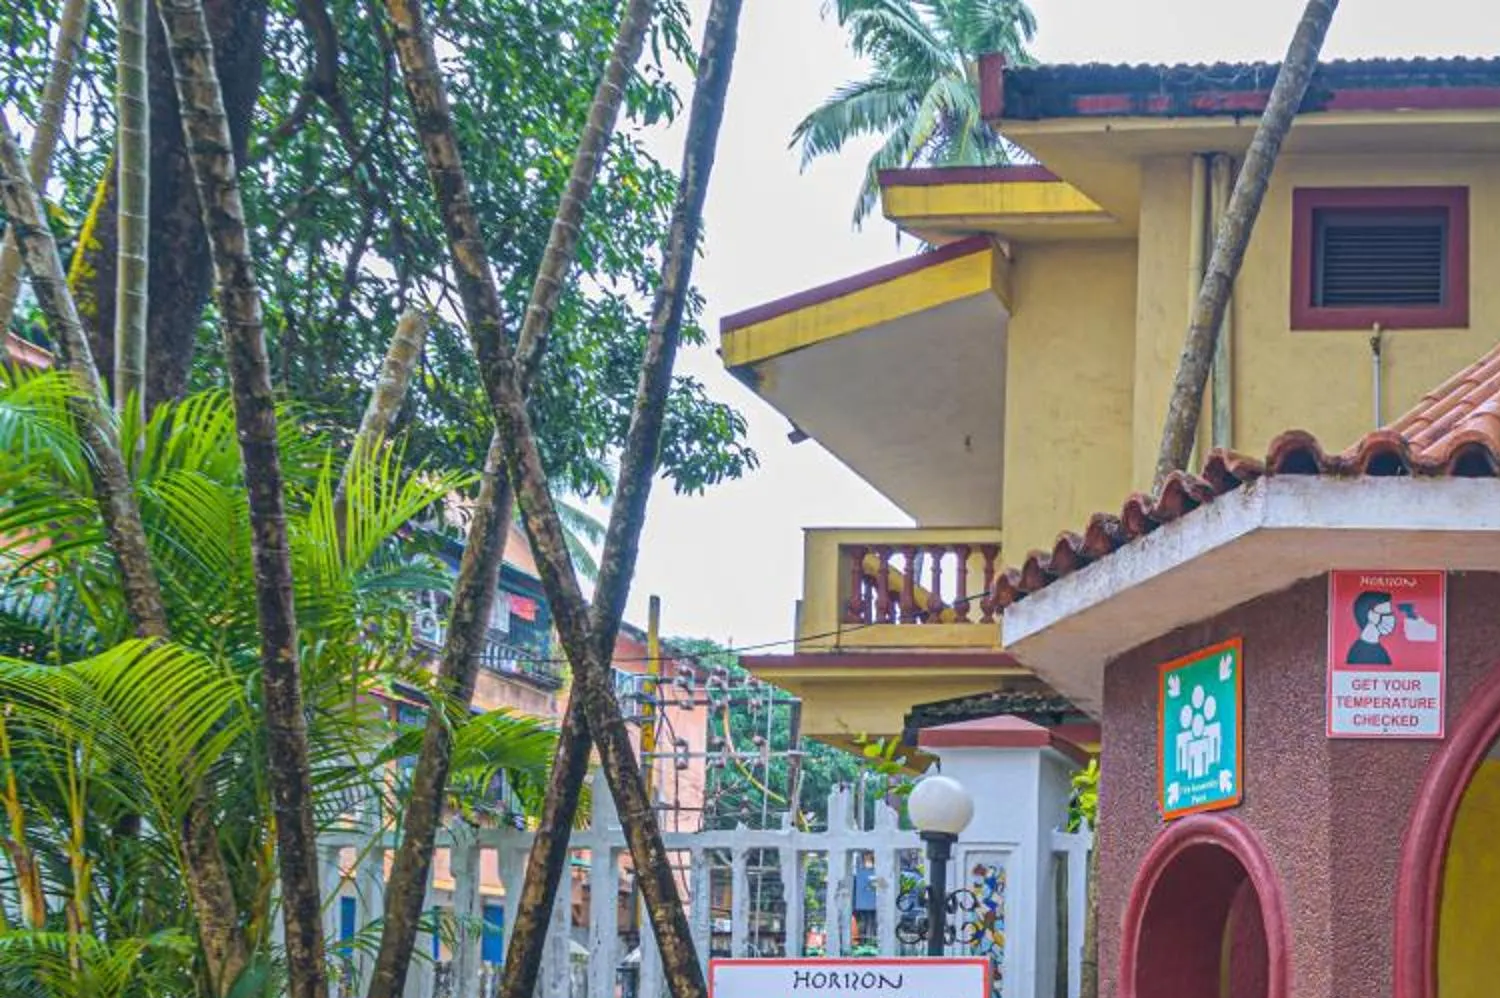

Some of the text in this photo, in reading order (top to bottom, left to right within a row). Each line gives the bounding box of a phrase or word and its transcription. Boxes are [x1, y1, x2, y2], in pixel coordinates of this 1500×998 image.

[1351, 679, 1421, 691] GET YOUR
[1336, 695, 1437, 709] TEMPERATURE
[1353, 713, 1419, 727] CHECKED
